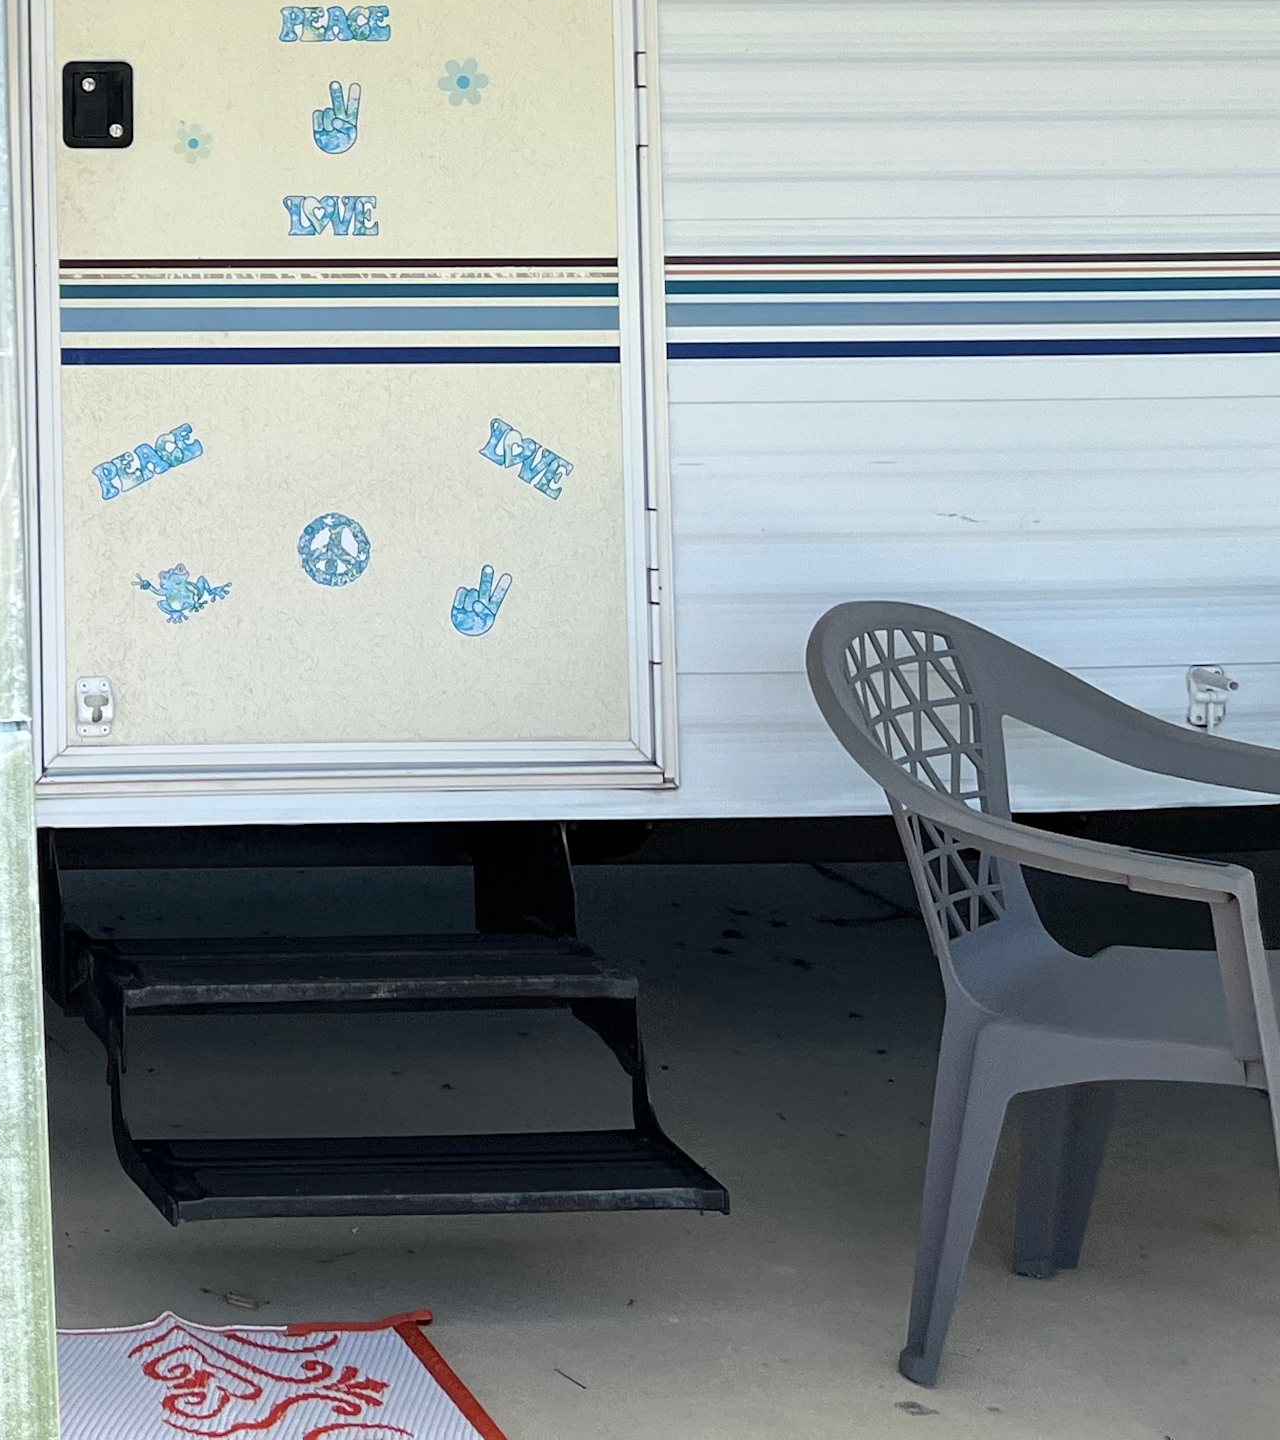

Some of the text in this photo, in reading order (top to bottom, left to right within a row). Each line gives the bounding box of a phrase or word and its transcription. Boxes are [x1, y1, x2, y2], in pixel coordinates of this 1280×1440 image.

[279, 5, 391, 42] PEACE
[282, 195, 379, 236] LOVE
[92, 422, 204, 500] PEACE
[478, 417, 574, 500] LOVE
